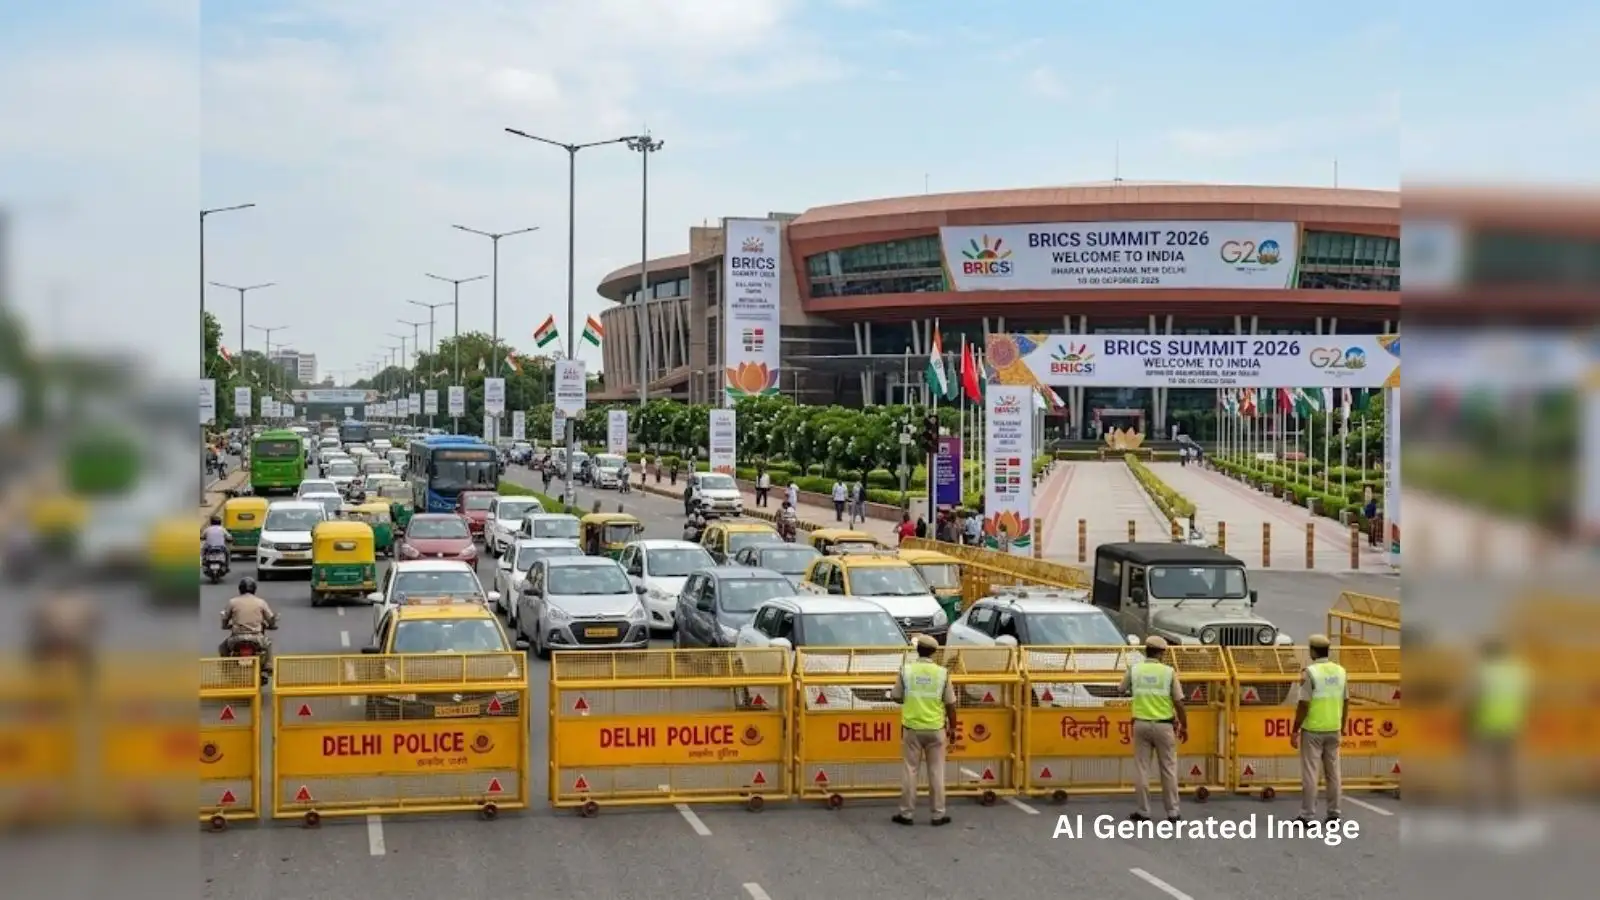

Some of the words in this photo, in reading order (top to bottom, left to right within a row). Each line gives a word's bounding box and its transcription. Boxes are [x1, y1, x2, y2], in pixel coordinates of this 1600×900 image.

[1028, 232, 1081, 247] BRICS
[1086, 231, 1161, 247] SUMMIT
[1166, 230, 1210, 246] 2026
[731, 257, 775, 270] BRICS
[1052, 250, 1121, 263] WELCOME
[1125, 250, 1143, 262] TO
[1147, 250, 1185, 262] INDIA
[963, 261, 1011, 274] BRICS
[1104, 340, 1161, 355] BRICS
[1167, 340, 1248, 355] SUMMIT
[1253, 340, 1300, 356] 2026
[1050, 362, 1092, 373] BRICS
[1143, 357, 1206, 368] WELCOME
[1208, 357, 1224, 368] TO
[1227, 358, 1261, 369] INDIA
[838, 721, 891, 741] DELHI
[1061, 715, 1110, 741] दिल्ली
[322, 734, 382, 756] DELHI
[393, 732, 464, 754] POLICE
[600, 727, 656, 748] DELHI
[667, 725, 733, 746] POLICE
